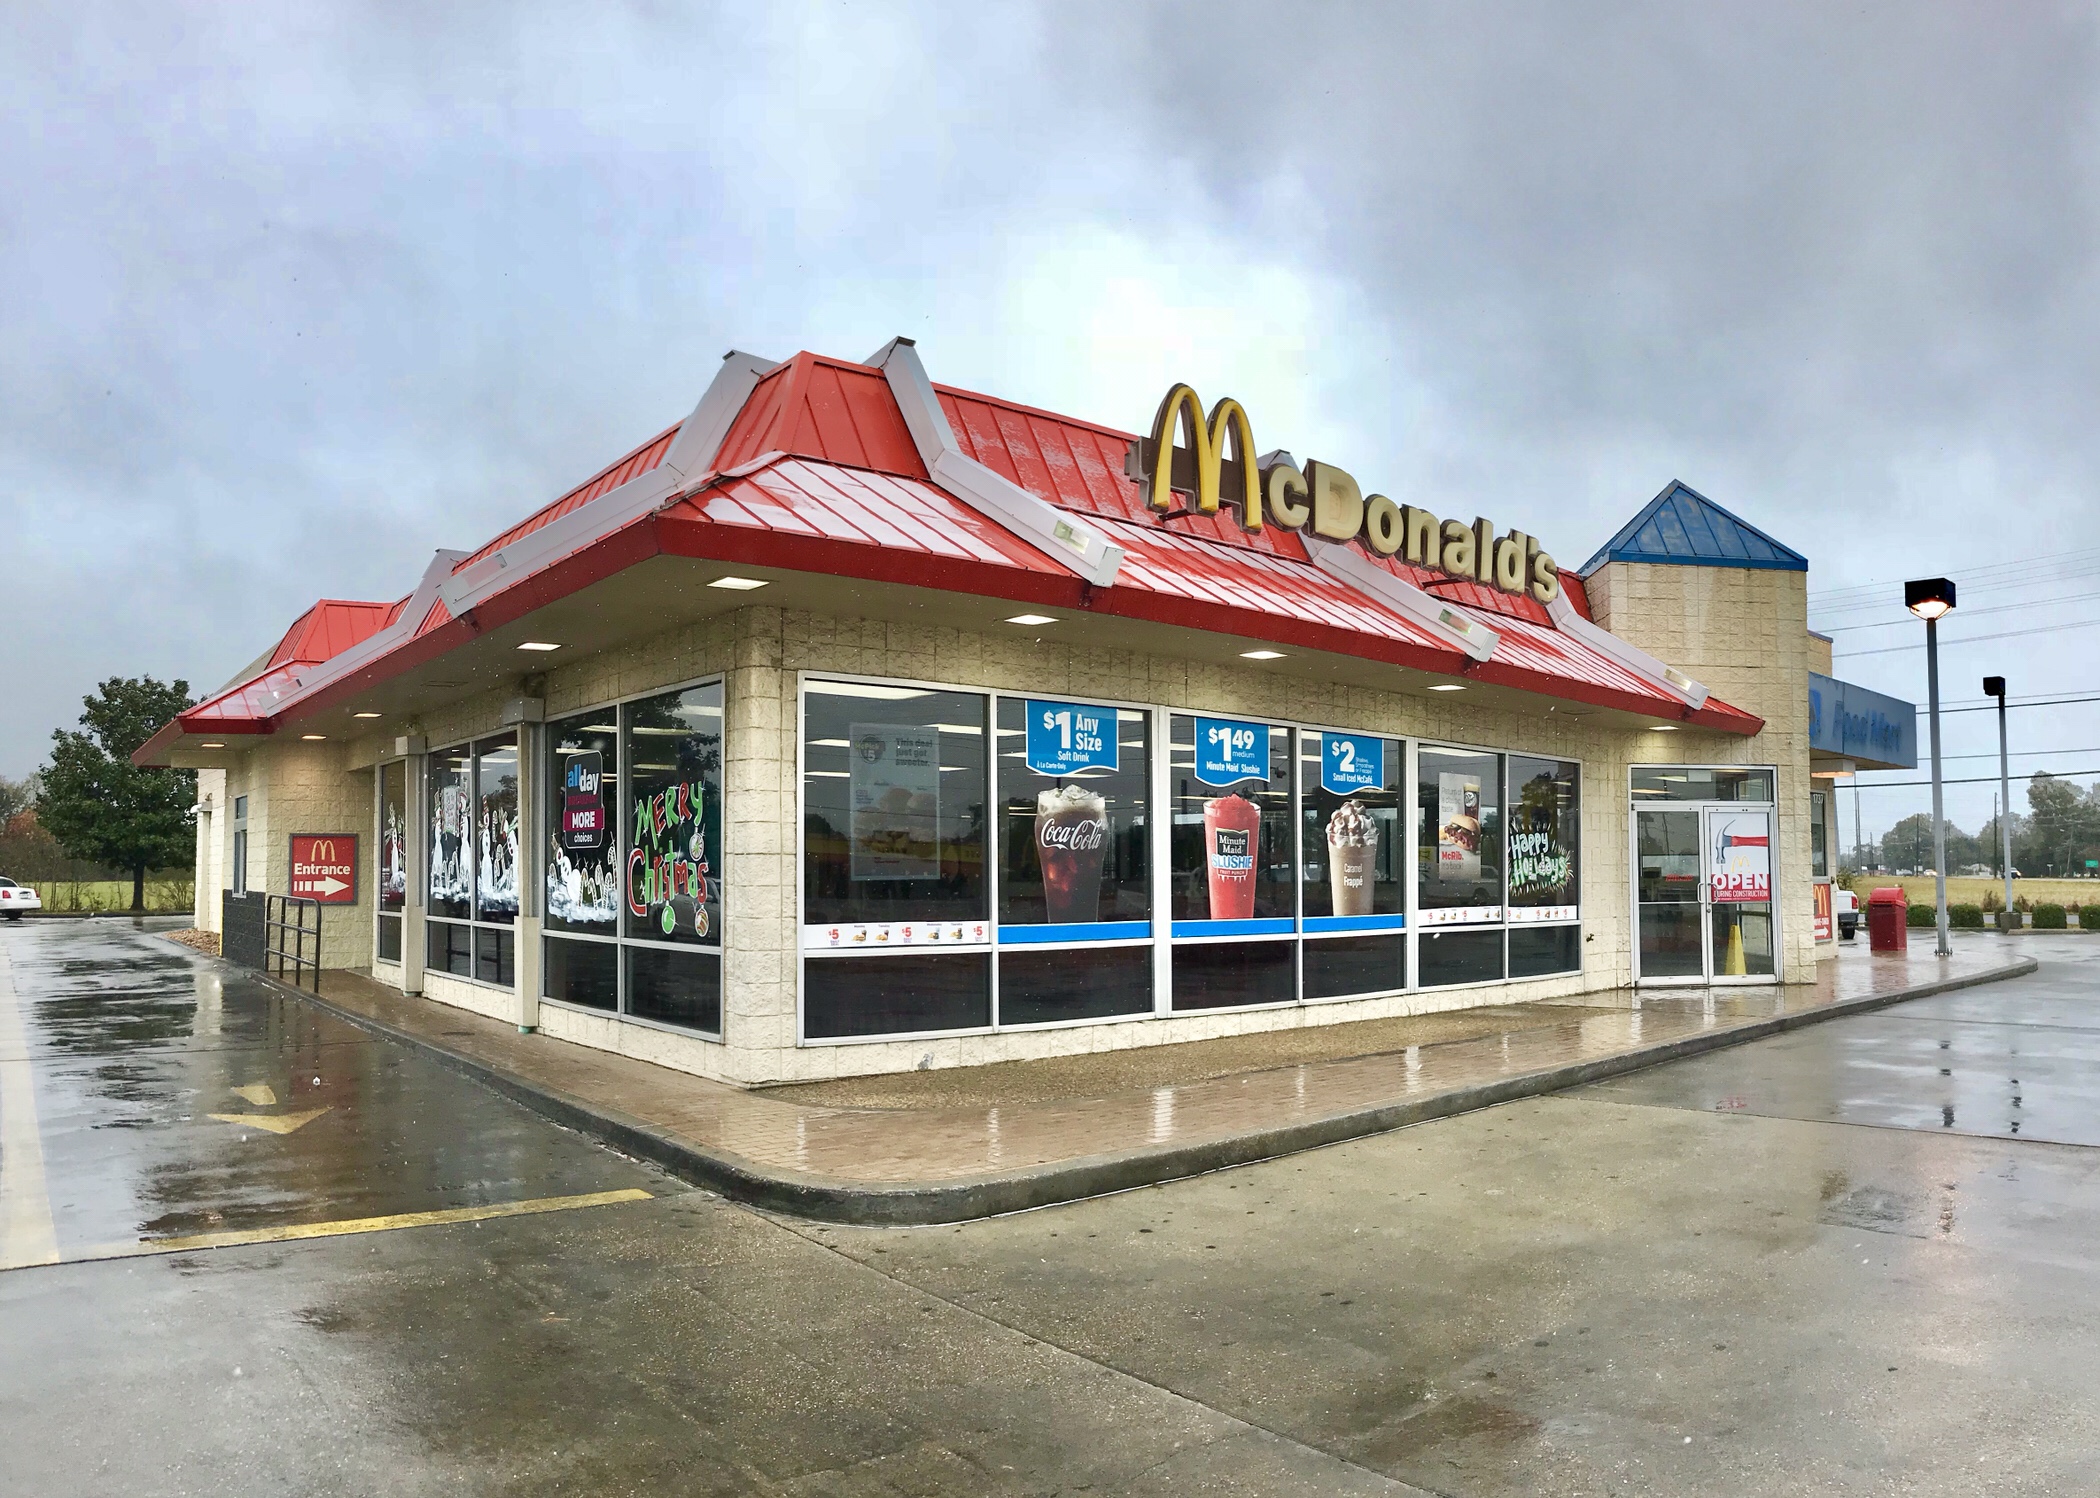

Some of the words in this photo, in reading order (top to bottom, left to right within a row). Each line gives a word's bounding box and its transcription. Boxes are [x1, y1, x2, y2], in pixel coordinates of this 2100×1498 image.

[1150, 383, 1559, 606] McDonald's
[1043, 709, 1071, 749] $1
[1075, 713, 1099, 735] Any
[895, 737, 914, 747] This
[914, 738, 933, 747] deal
[1075, 732, 1102, 751] Size
[895, 748, 912, 757] just
[913, 749, 927, 758] got
[1057, 750, 1072, 761] Soft
[1072, 751, 1090, 762] Drink
[1331, 740, 1355, 773] $2
[895, 758, 931, 767] sweeter.
[1206, 760, 1225, 771] Minute
[1225, 762, 1239, 772] Maid
[1240, 763, 1260, 774] Slushie
[1333, 772, 1346, 781] Small
[1346, 773, 1356, 782] Iced
[1356, 774, 1373, 784] McCafé
[572, 810, 596, 829] MORE
[634, 781, 703, 850] MERRY
[573, 832, 593, 843] choices
[1040, 817, 1103, 850] Coca-Cola
[1219, 834, 1246, 845] Minute
[1222, 843, 1242, 854] Maid
[1212, 854, 1253, 869] SLUSHIE
[1343, 862, 1362, 873] Caramel
[294, 862, 351, 875] Entrance
[627, 839, 709, 917] Christmas
[1343, 875, 1362, 889] Frappé
[1712, 872, 1768, 890] OPEN
[1732, 889, 1768, 898] CONSTRUCTION
[828, 928, 839, 940] $5
[901, 926, 912, 938] $5
[973, 925, 983, 937] $5
